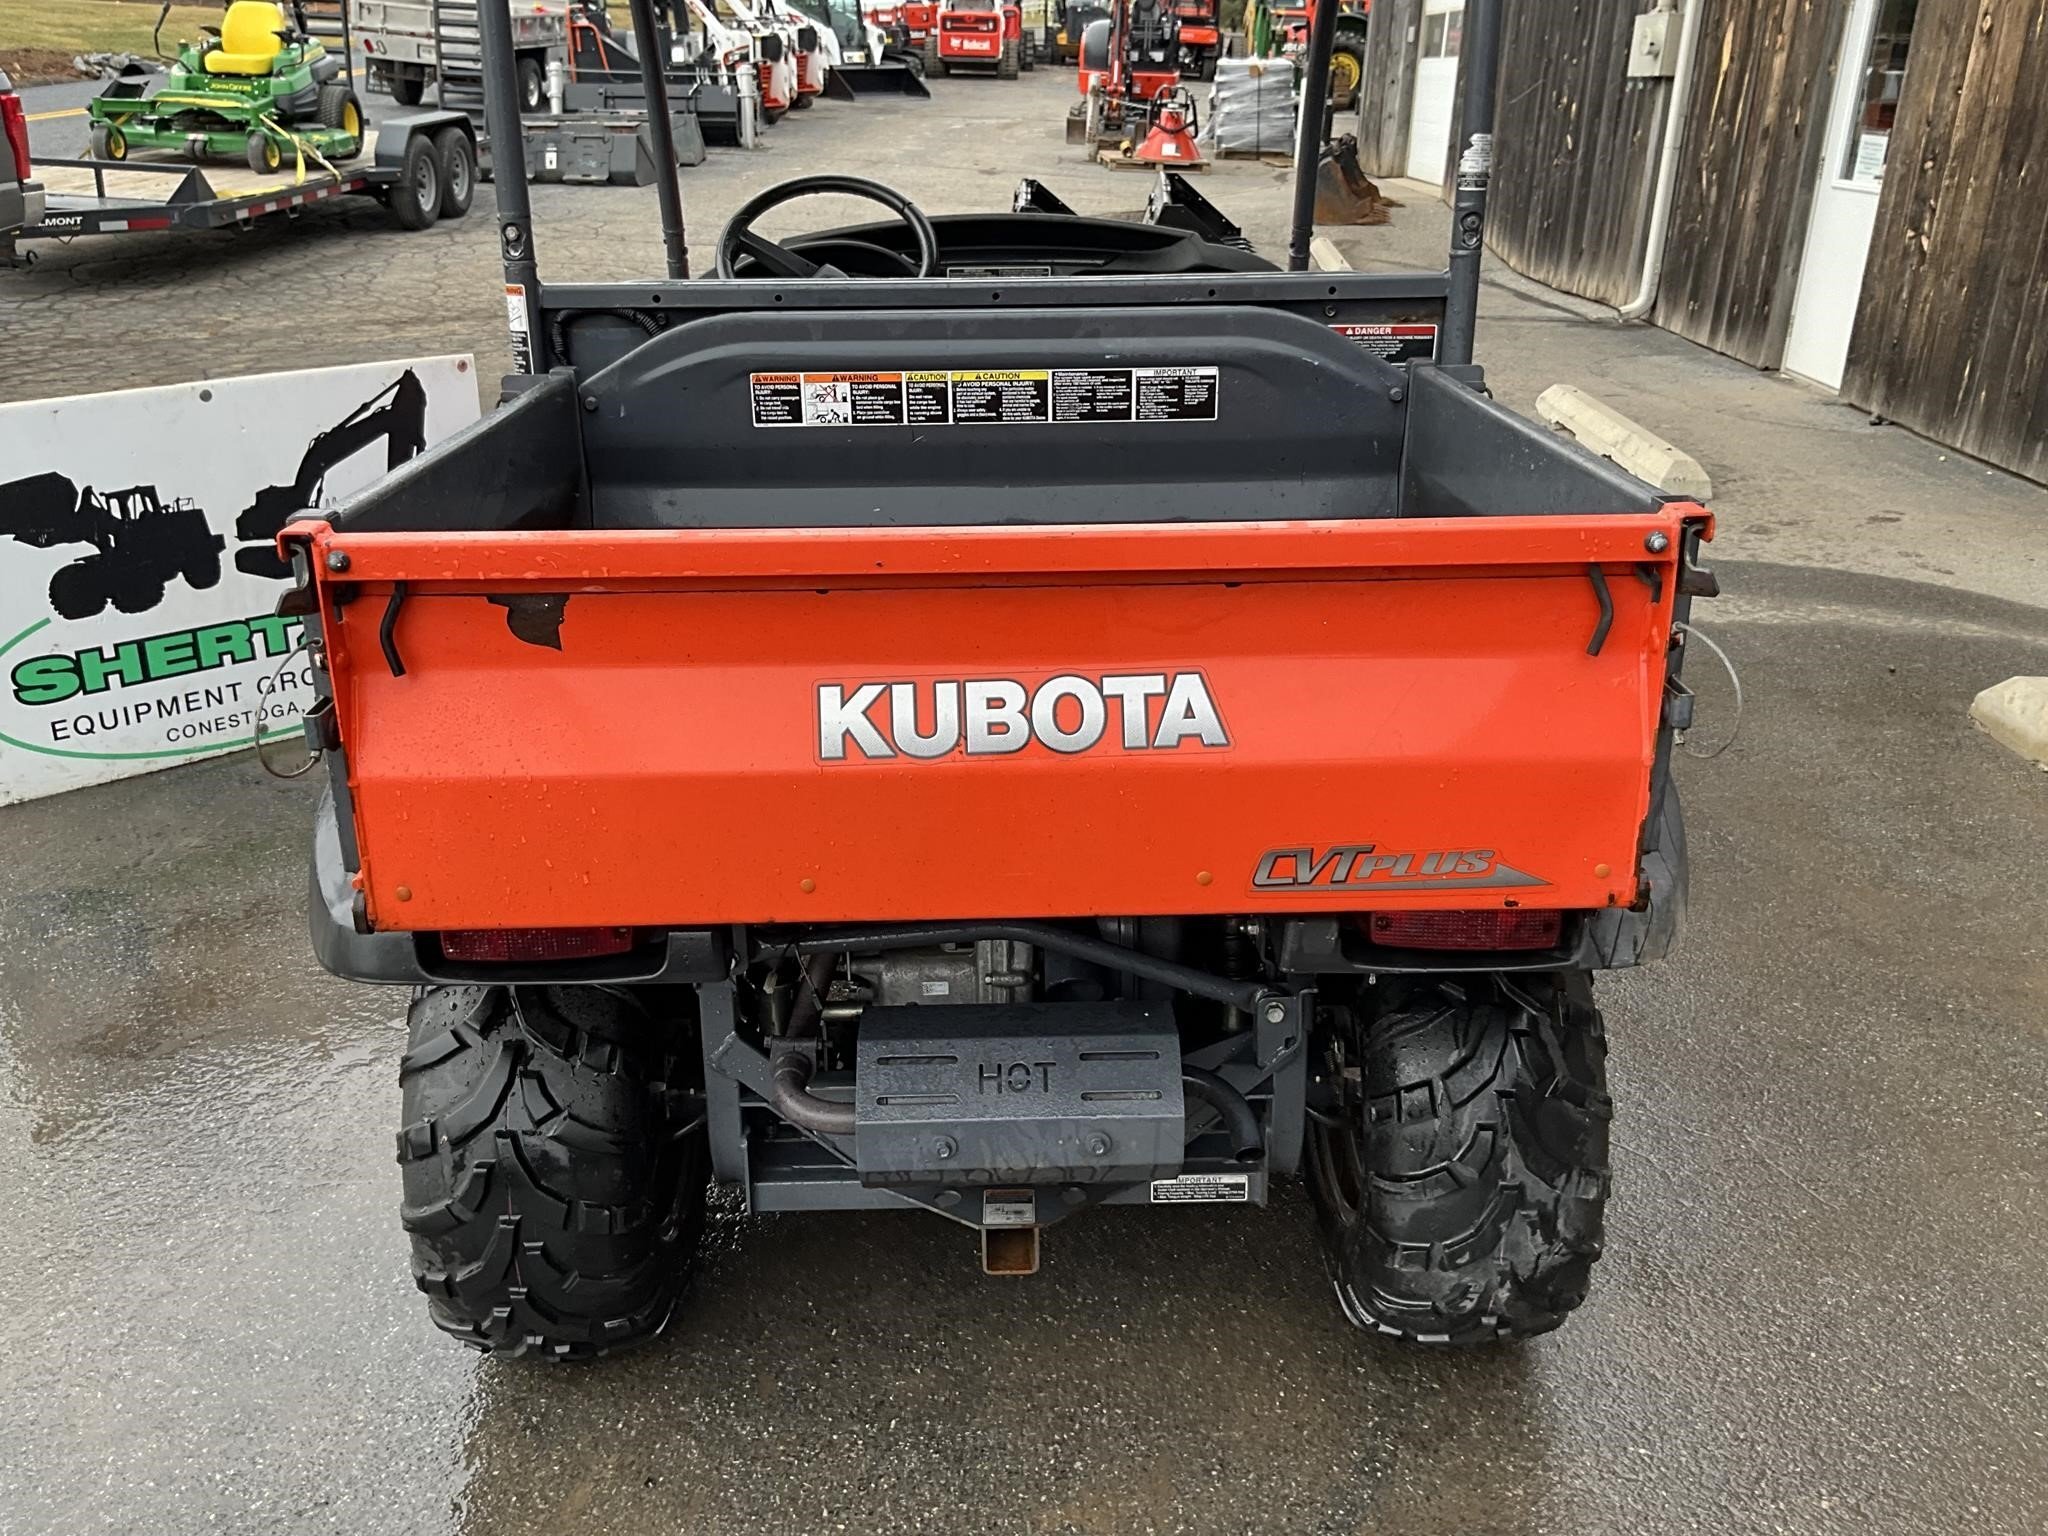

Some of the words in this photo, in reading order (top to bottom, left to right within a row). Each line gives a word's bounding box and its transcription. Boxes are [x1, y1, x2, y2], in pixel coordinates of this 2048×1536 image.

[11, 613, 306, 706] SHERT
[50, 682, 242, 741] EQUIPMENT
[817, 673, 1230, 760] KUBOTA
[1253, 845, 1376, 886] CVT
[1356, 850, 1495, 878] PLUS
[978, 1061, 1056, 1094] HOT
